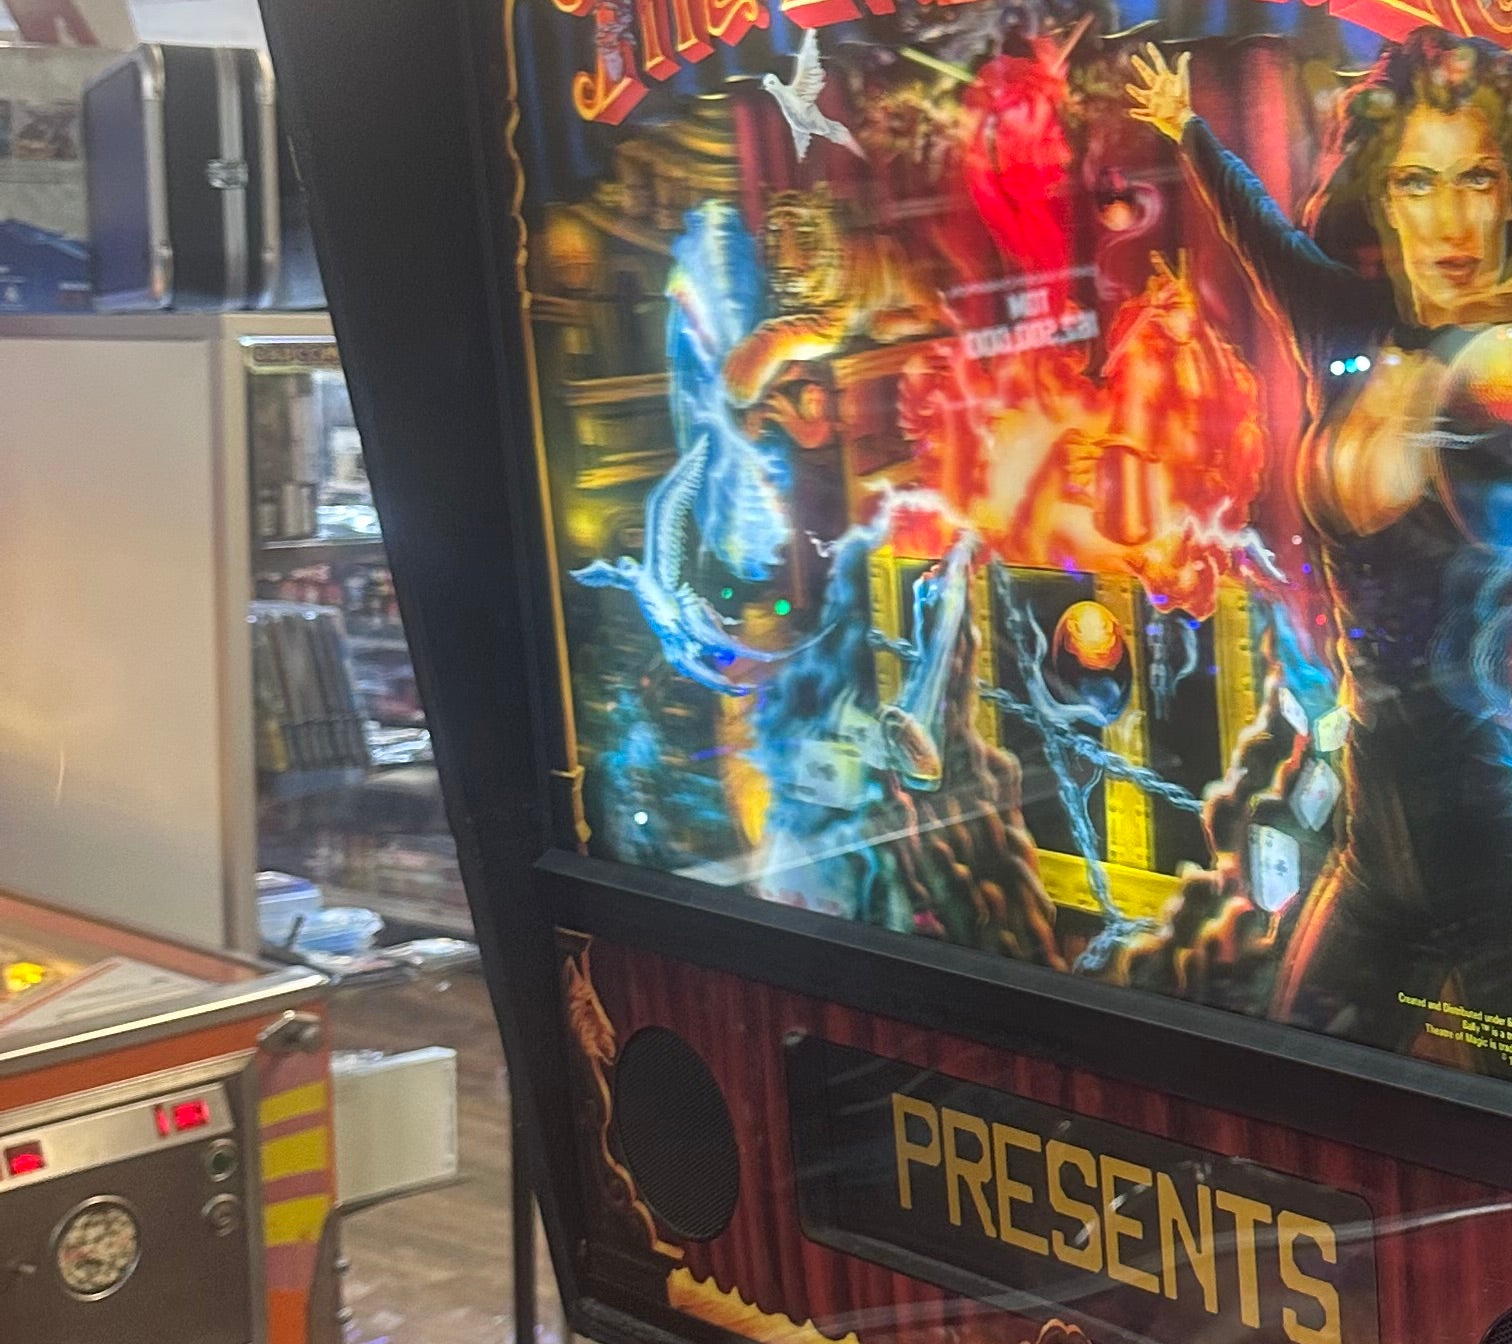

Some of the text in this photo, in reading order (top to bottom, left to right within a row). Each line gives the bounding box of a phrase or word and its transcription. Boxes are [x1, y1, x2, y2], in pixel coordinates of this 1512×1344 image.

[1398, 992, 1427, 1008] Created
[1427, 1000, 1442, 1012] and
[1484, 1014, 1506, 1025] under
[1425, 1022, 1454, 1039] Theatre
[1455, 1031, 1464, 1041] of
[1465, 1032, 1488, 1048] Magic
